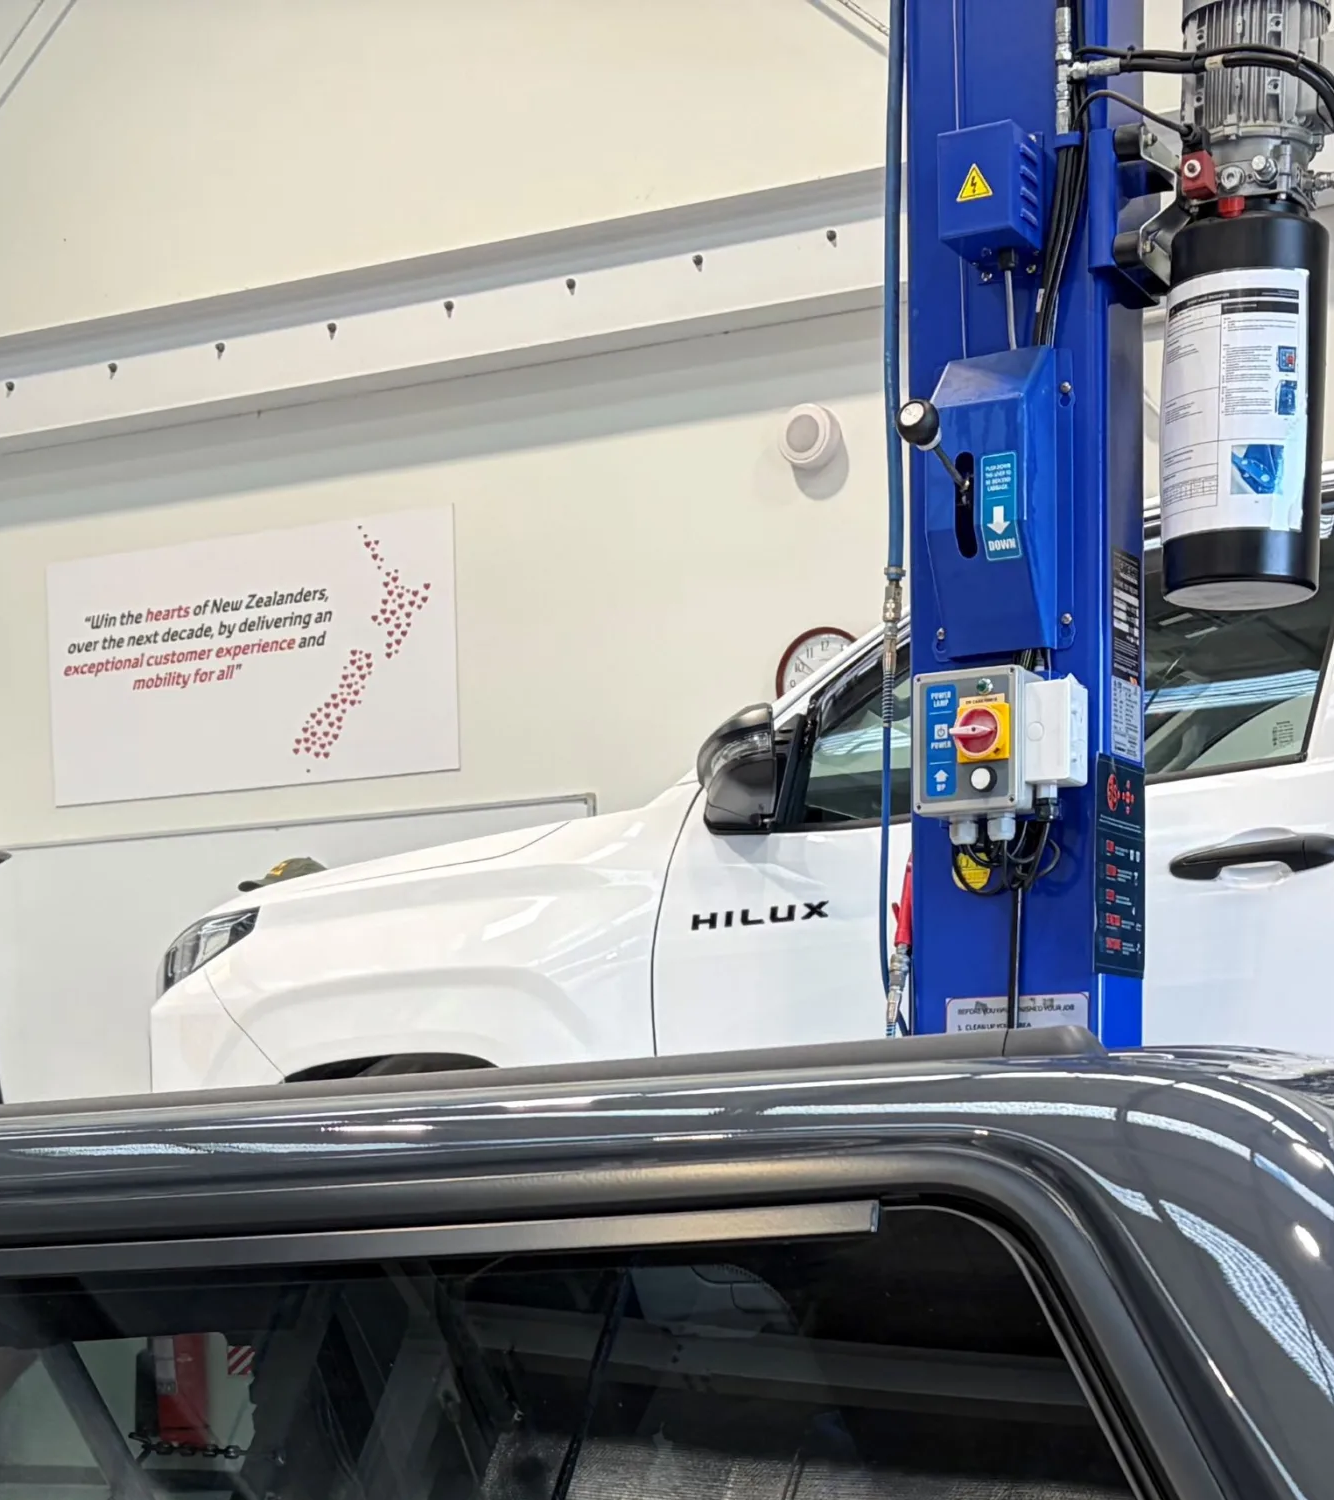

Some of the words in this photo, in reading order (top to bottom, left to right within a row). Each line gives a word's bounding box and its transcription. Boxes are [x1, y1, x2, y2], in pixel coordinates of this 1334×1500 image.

[988, 538, 1016, 551] DOWN
[119, 610, 143, 626] the
[145, 605, 191, 623] hearts
[193, 599, 210, 617] of
[210, 598, 243, 614] New
[244, 587, 329, 610] Zealanders,
[67, 640, 99, 655] over
[101, 635, 125, 651] the
[127, 630, 160, 647] next
[161, 623, 215, 643] decade,
[217, 620, 236, 639] by
[238, 612, 313, 633] delivering
[314, 610, 333, 624] an
[63, 653, 145, 677] exceptional
[146, 647, 213, 667] customer
[215, 638, 296, 661] experience
[298, 631, 327, 649] and
[132, 670, 191, 692] mobility
[192, 667, 215, 685] for
[930, 741, 952, 750] POWER
[690, 899, 830, 931] HILUX
